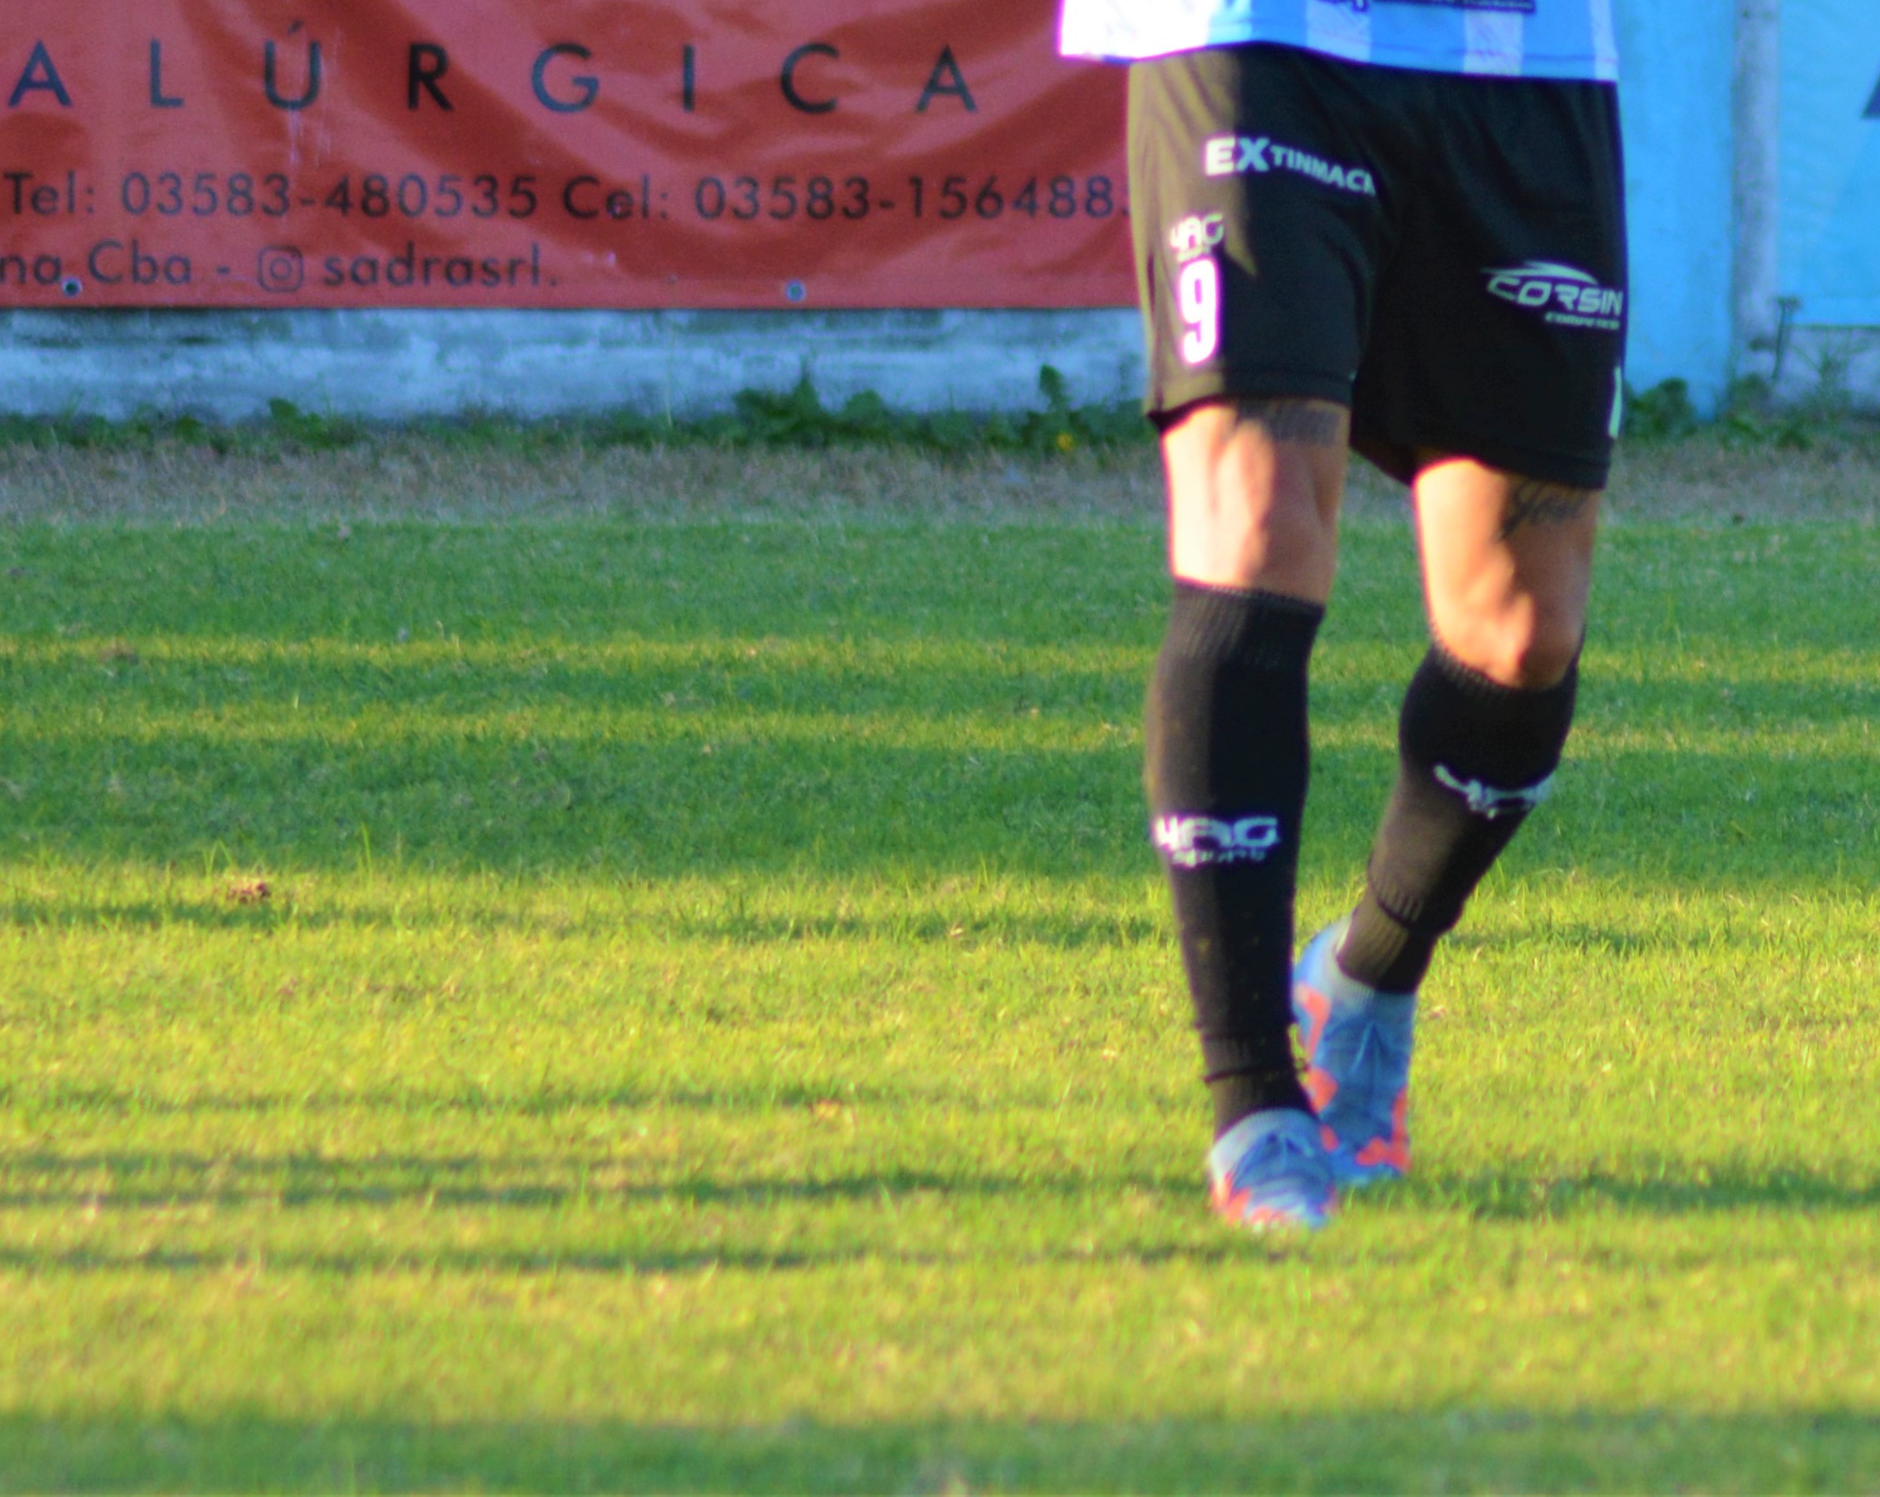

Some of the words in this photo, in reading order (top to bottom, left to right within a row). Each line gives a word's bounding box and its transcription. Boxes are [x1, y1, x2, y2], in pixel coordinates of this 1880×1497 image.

[8, 21, 978, 114] ALÚRGICA
[3, 171, 95, 216] Tel:
[121, 171, 538, 219] 03583-480535
[562, 175, 670, 219] Cel:
[694, 175, 1130, 221] 03583-156488
[87, 239, 193, 287] Cba
[1178, 258, 1219, 366] 9
